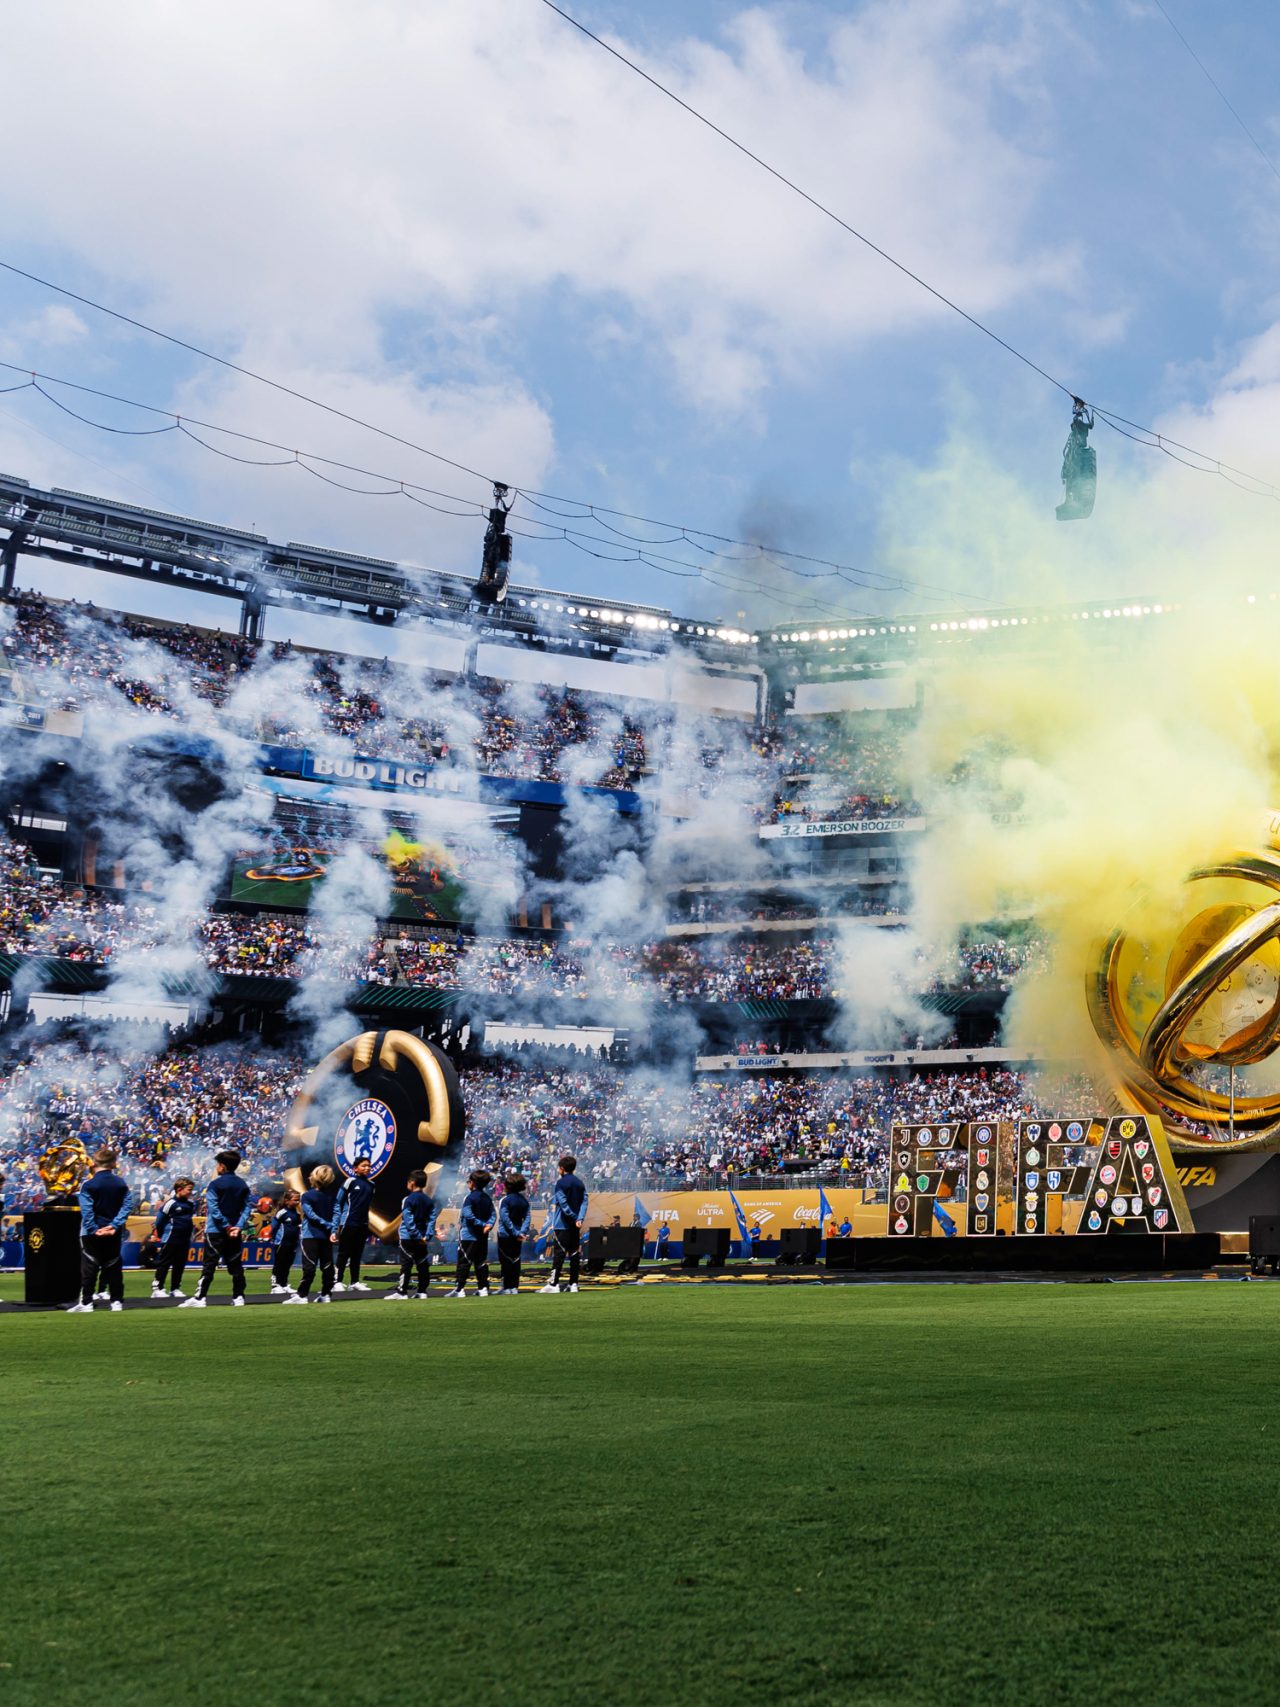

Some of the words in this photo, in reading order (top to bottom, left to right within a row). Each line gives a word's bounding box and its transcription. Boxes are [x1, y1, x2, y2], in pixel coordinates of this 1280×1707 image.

[313, 757, 376, 780] BUD
[380, 765, 464, 793] LIGHT
[806, 822, 859, 834] EMERSON
[861, 820, 905, 832] BOOZER
[738, 1058, 754, 1066] BUD
[755, 1058, 776, 1066] LIGHT
[348, 1101, 388, 1120] CHELSEA
[887, 1115, 1182, 1237] FIFA
[1176, 1166, 1217, 1186] IFA
[652, 1209, 680, 1222] FIFA
[697, 1208, 724, 1216] ULTRA
[792, 1205, 833, 1221] Coca-Coa
